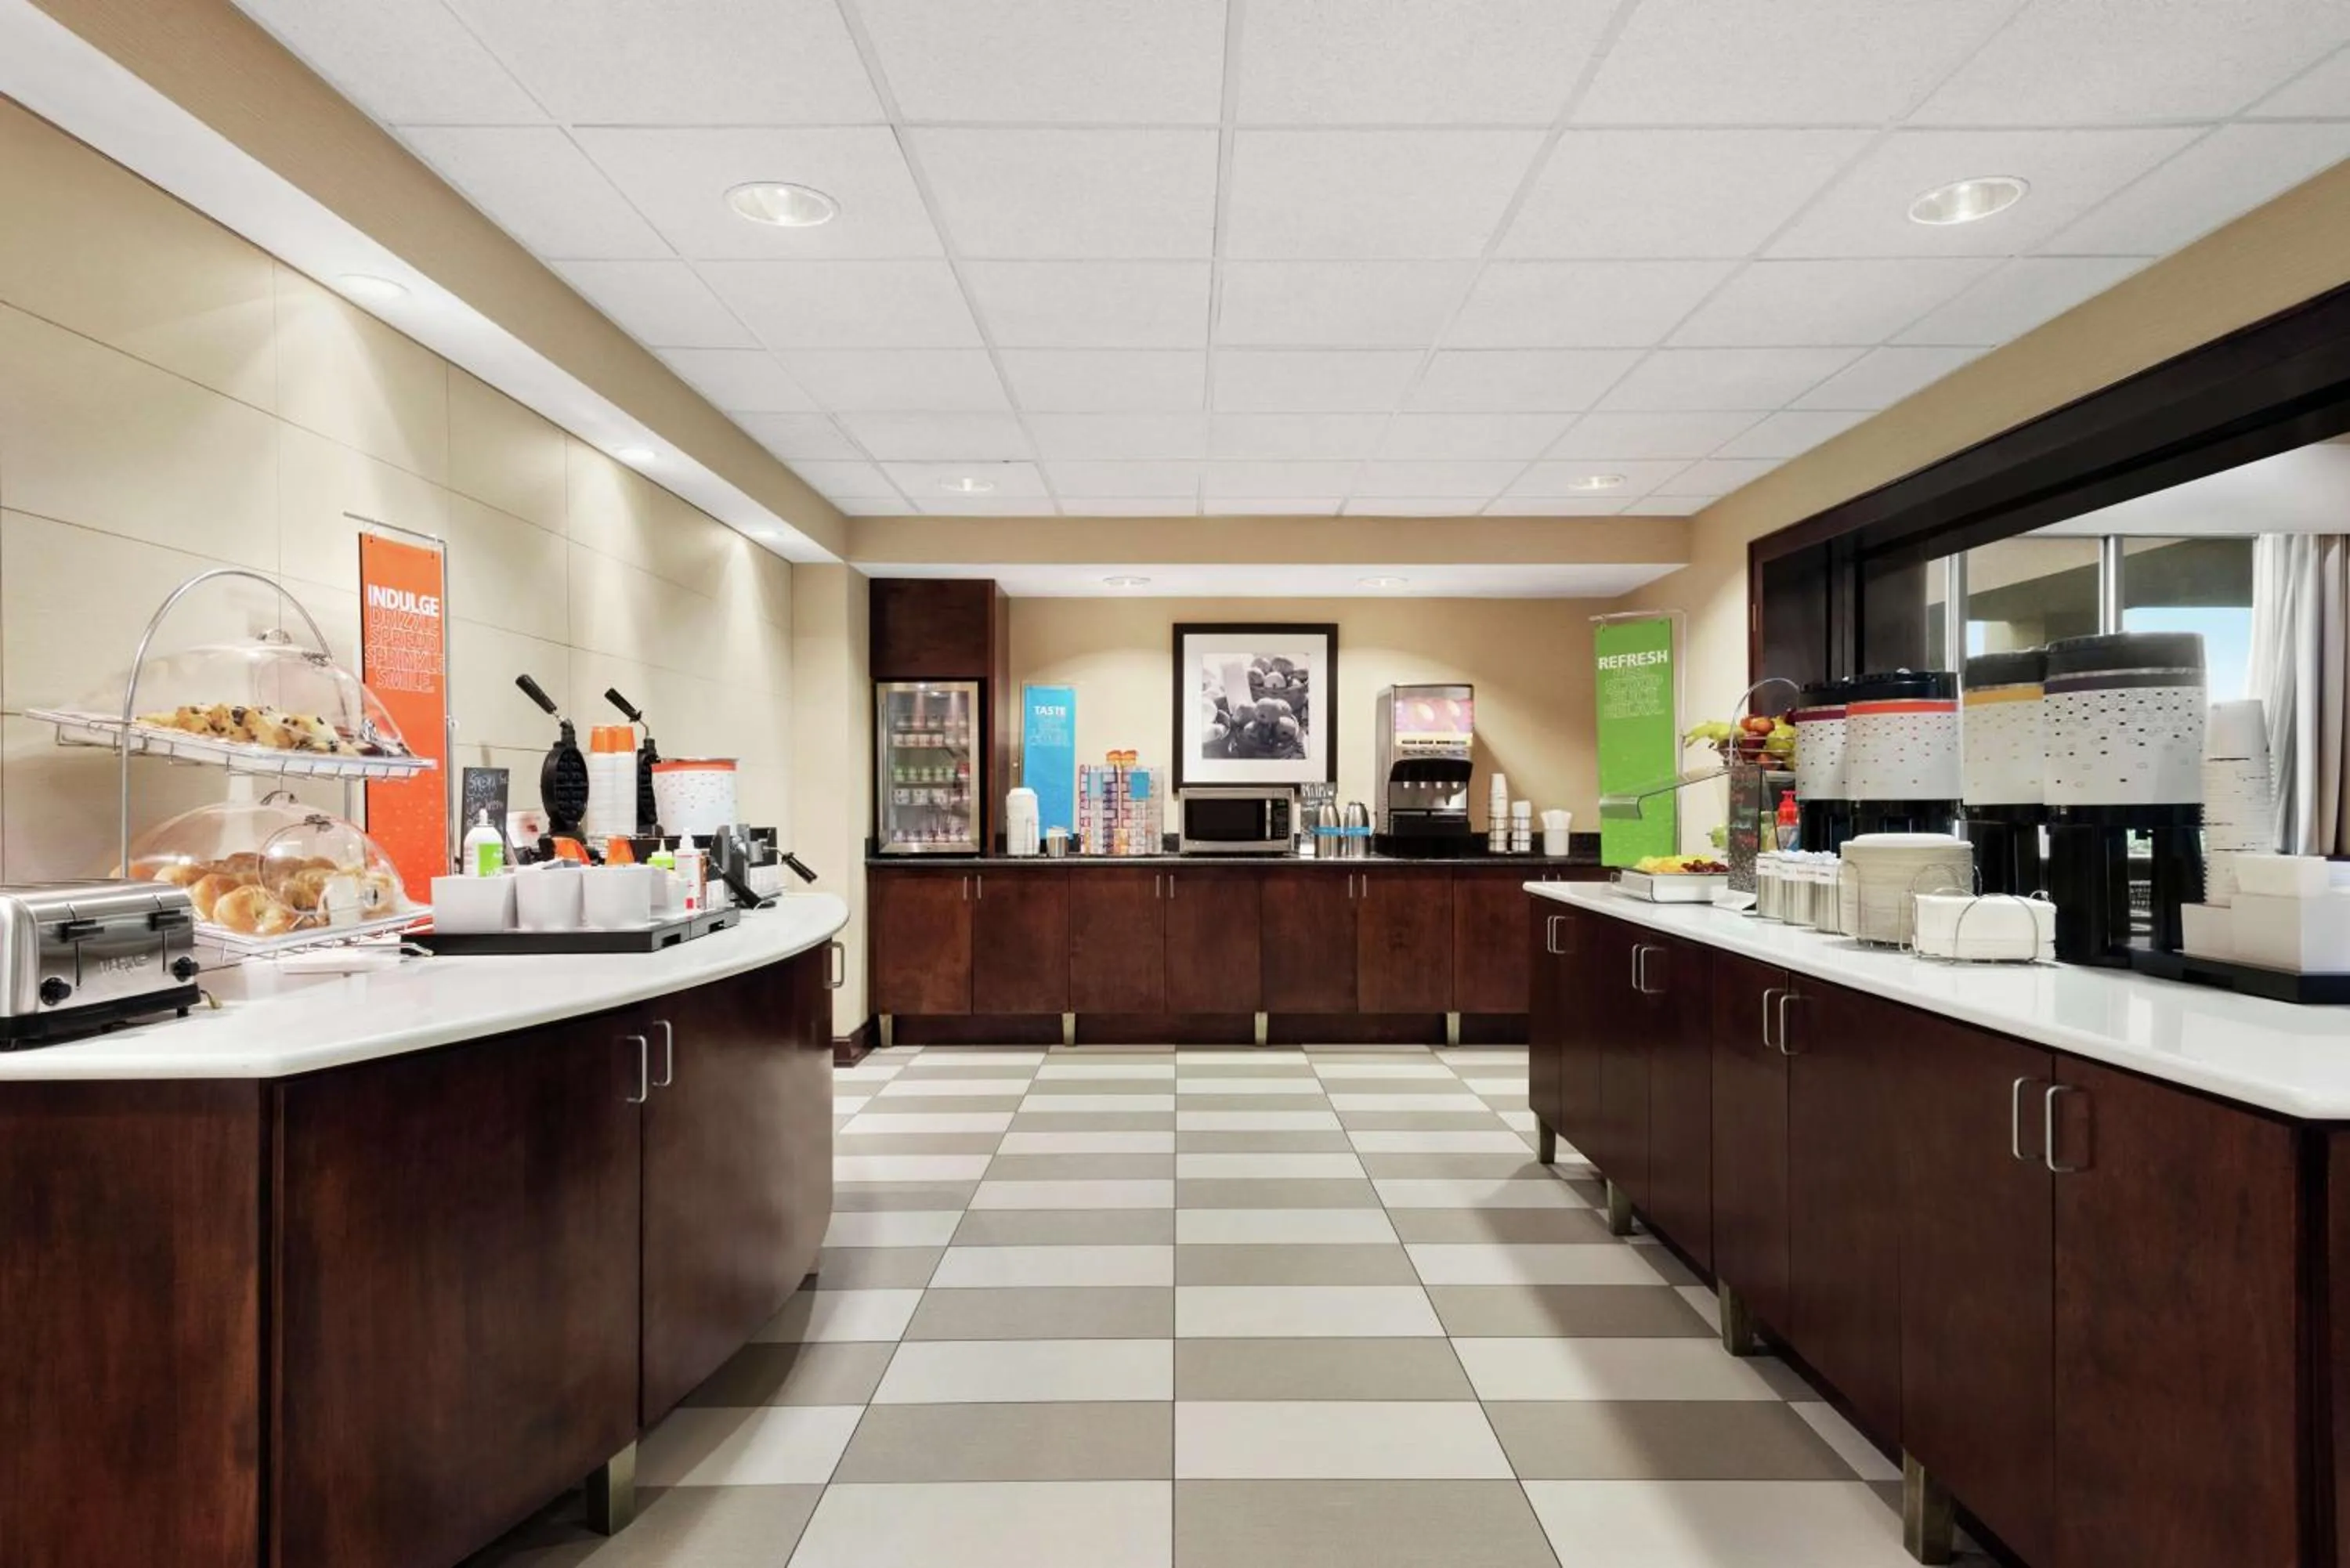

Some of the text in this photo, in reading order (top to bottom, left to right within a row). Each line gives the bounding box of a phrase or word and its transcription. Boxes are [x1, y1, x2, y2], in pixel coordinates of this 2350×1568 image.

[367, 583, 439, 618] INDULGE
[1599, 650, 1668, 670] REFRESH
[1033, 705, 1066, 716] TASTE
